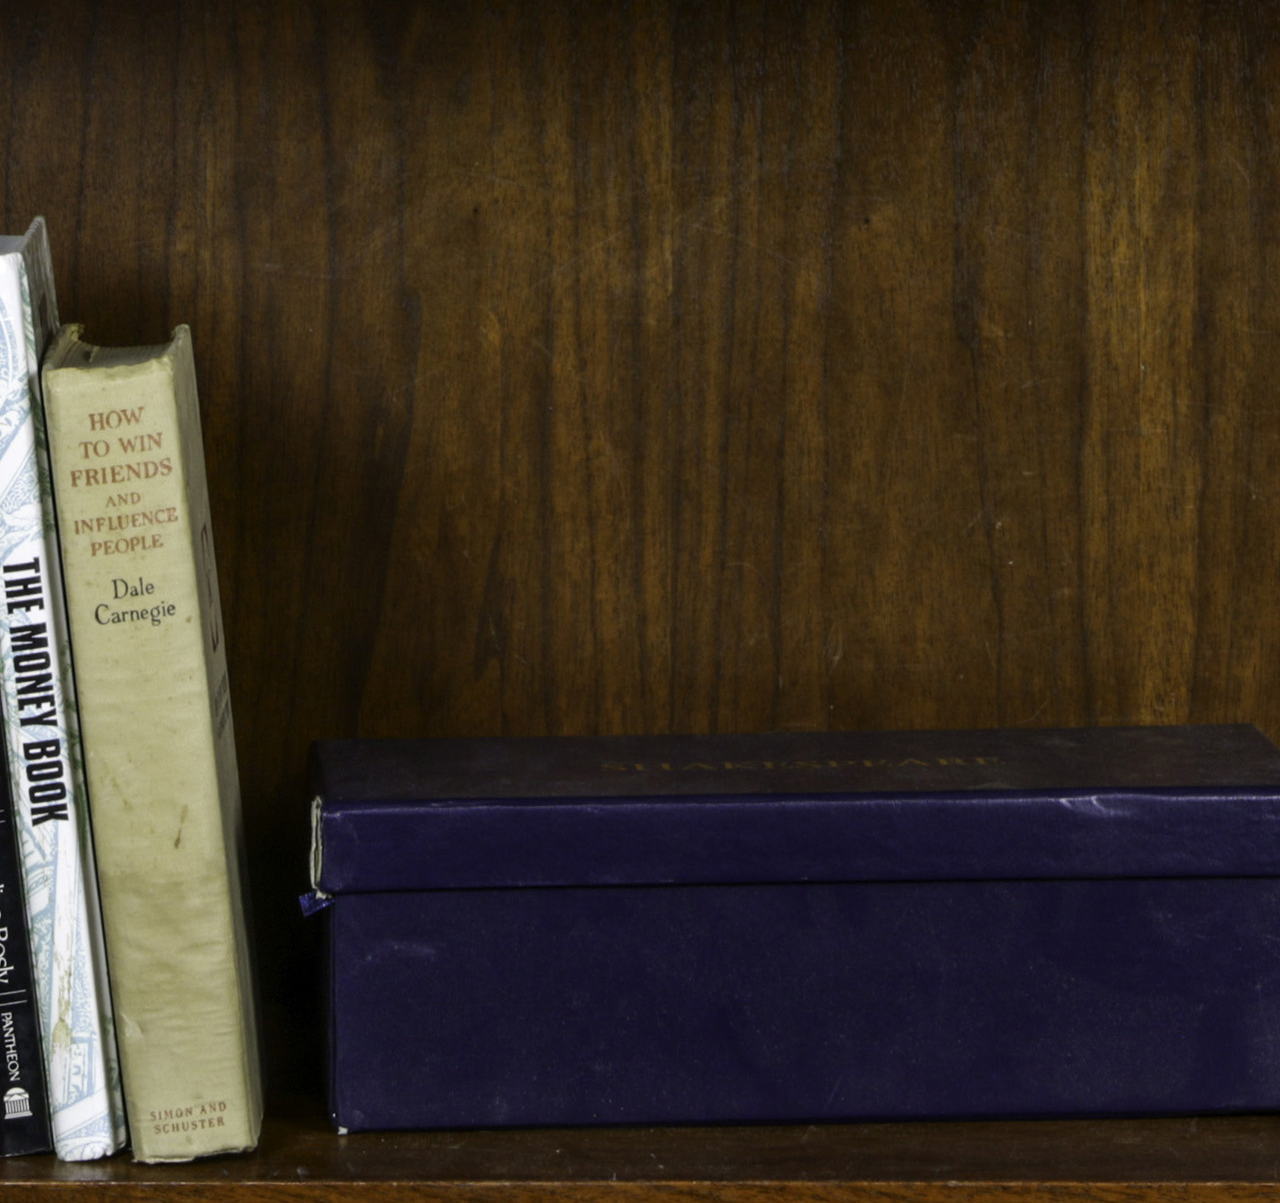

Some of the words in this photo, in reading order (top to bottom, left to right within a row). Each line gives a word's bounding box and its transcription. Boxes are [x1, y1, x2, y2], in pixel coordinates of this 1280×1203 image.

[89, 407, 144, 432] HOW
[80, 435, 112, 461] TO
[118, 432, 163, 456] WIN
[70, 457, 173, 488] FRIENDS
[105, 490, 141, 509] AND
[73, 507, 179, 536] INFLUENCE
[90, 533, 164, 557] PEOPLE
[3, 556, 44, 615] THE
[112, 577, 155, 600] Dale
[94, 599, 177, 627] Carnegie
[9, 621, 60, 733] MONEY
[27, 737, 69, 826] BOOK
[1, 1011, 21, 1082] PANTHEON
[150, 1106, 194, 1123] SIMON
[200, 1102, 227, 1116] AND
[154, 1116, 226, 1135] SCHUSTER
